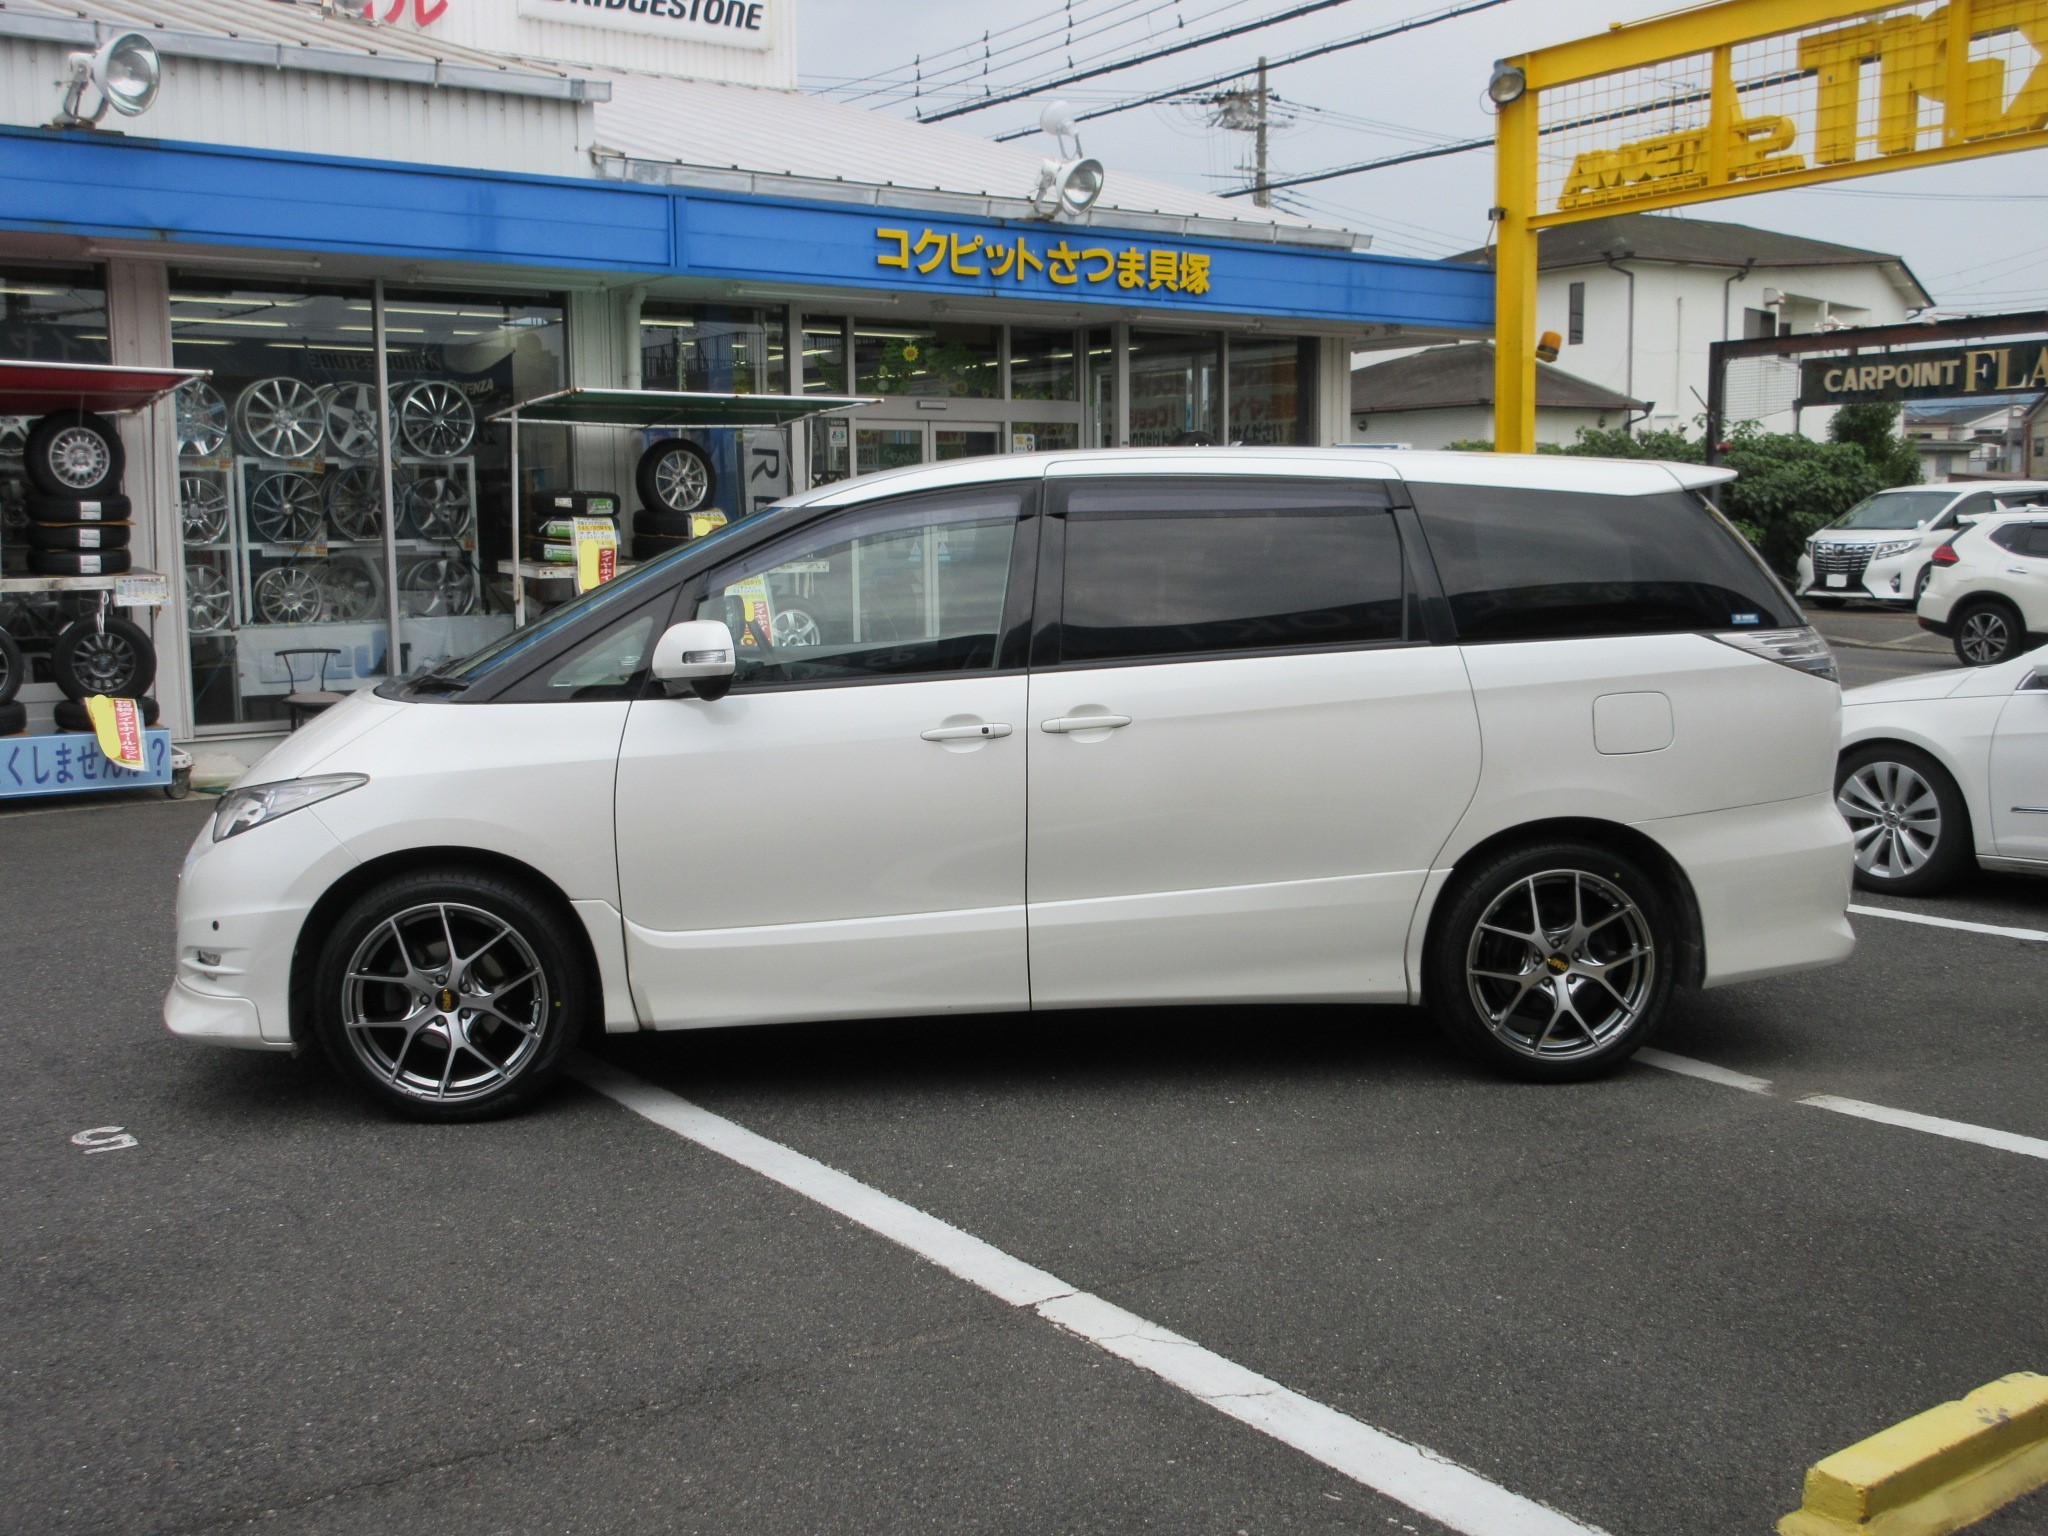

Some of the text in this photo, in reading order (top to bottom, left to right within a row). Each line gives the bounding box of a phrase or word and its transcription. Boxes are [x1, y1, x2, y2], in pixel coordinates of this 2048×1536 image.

[362, 0, 449, 27] ル
[538, 0, 763, 30] GESTONE
[877, 228, 1211, 294] コクピットさつま貝塚
[1823, 360, 1961, 393] CARPOINT
